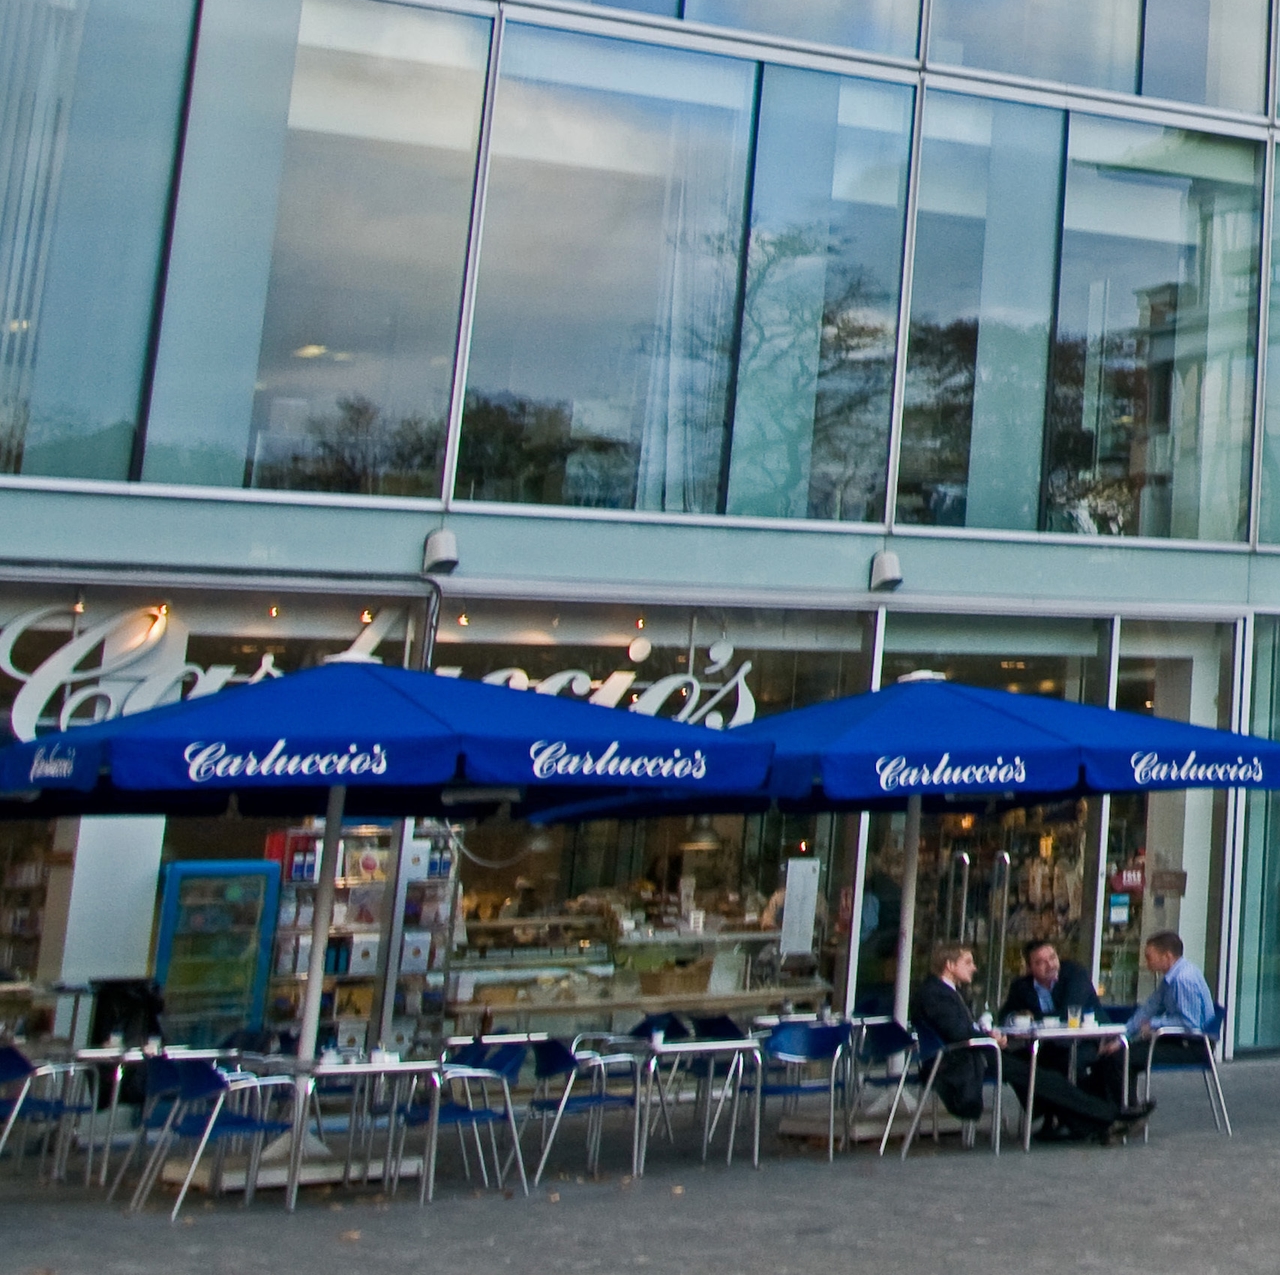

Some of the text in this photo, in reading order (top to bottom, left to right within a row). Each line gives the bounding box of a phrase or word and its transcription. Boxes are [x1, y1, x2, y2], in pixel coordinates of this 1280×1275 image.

[183, 739, 387, 782] Carluccio's
[529, 740, 707, 780] Carluccio's
[875, 752, 1026, 791] Carluccio's
[1130, 750, 1263, 785] Carluccio's
